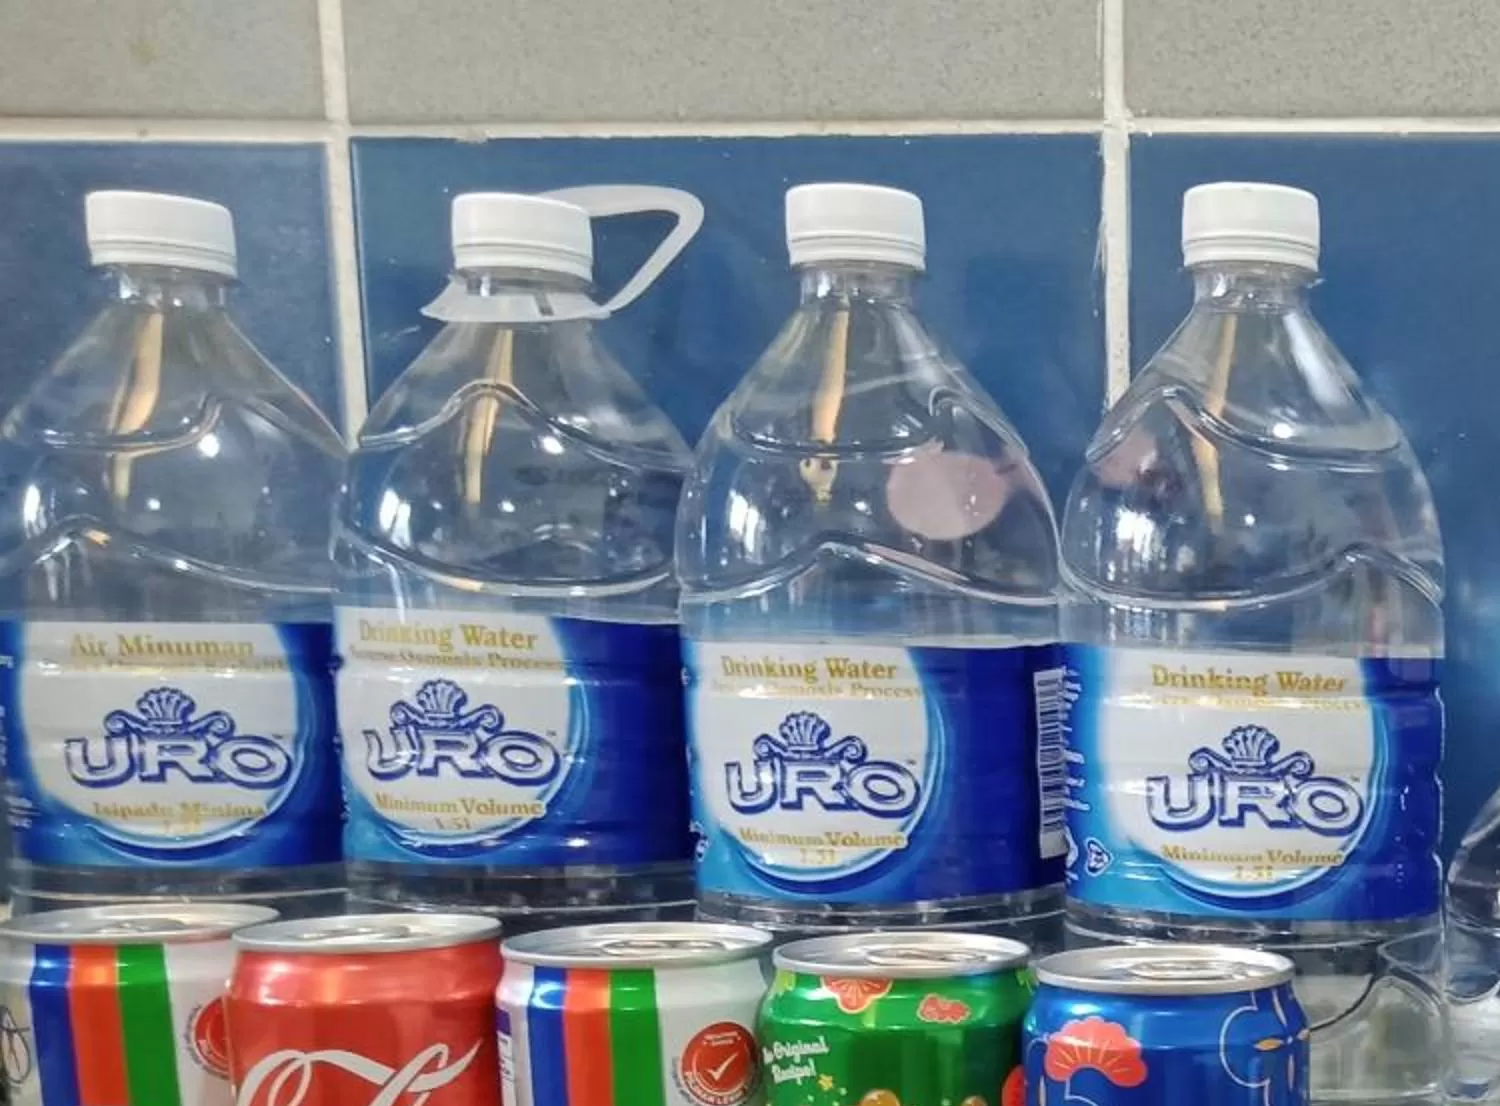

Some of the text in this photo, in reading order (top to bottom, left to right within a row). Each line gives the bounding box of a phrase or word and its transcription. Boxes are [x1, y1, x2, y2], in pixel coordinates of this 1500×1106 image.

[117, 633, 254, 657] Minuman
[359, 619, 539, 652] Drinking Water
[720, 655, 898, 684] Drinking Water
[1152, 664, 1349, 697] Drinking Water
[64, 734, 293, 790] URO
[361, 728, 561, 787] URO
[723, 760, 922, 819] URO
[460, 797, 544, 817] Volume
[1145, 775, 1365, 838] URO
